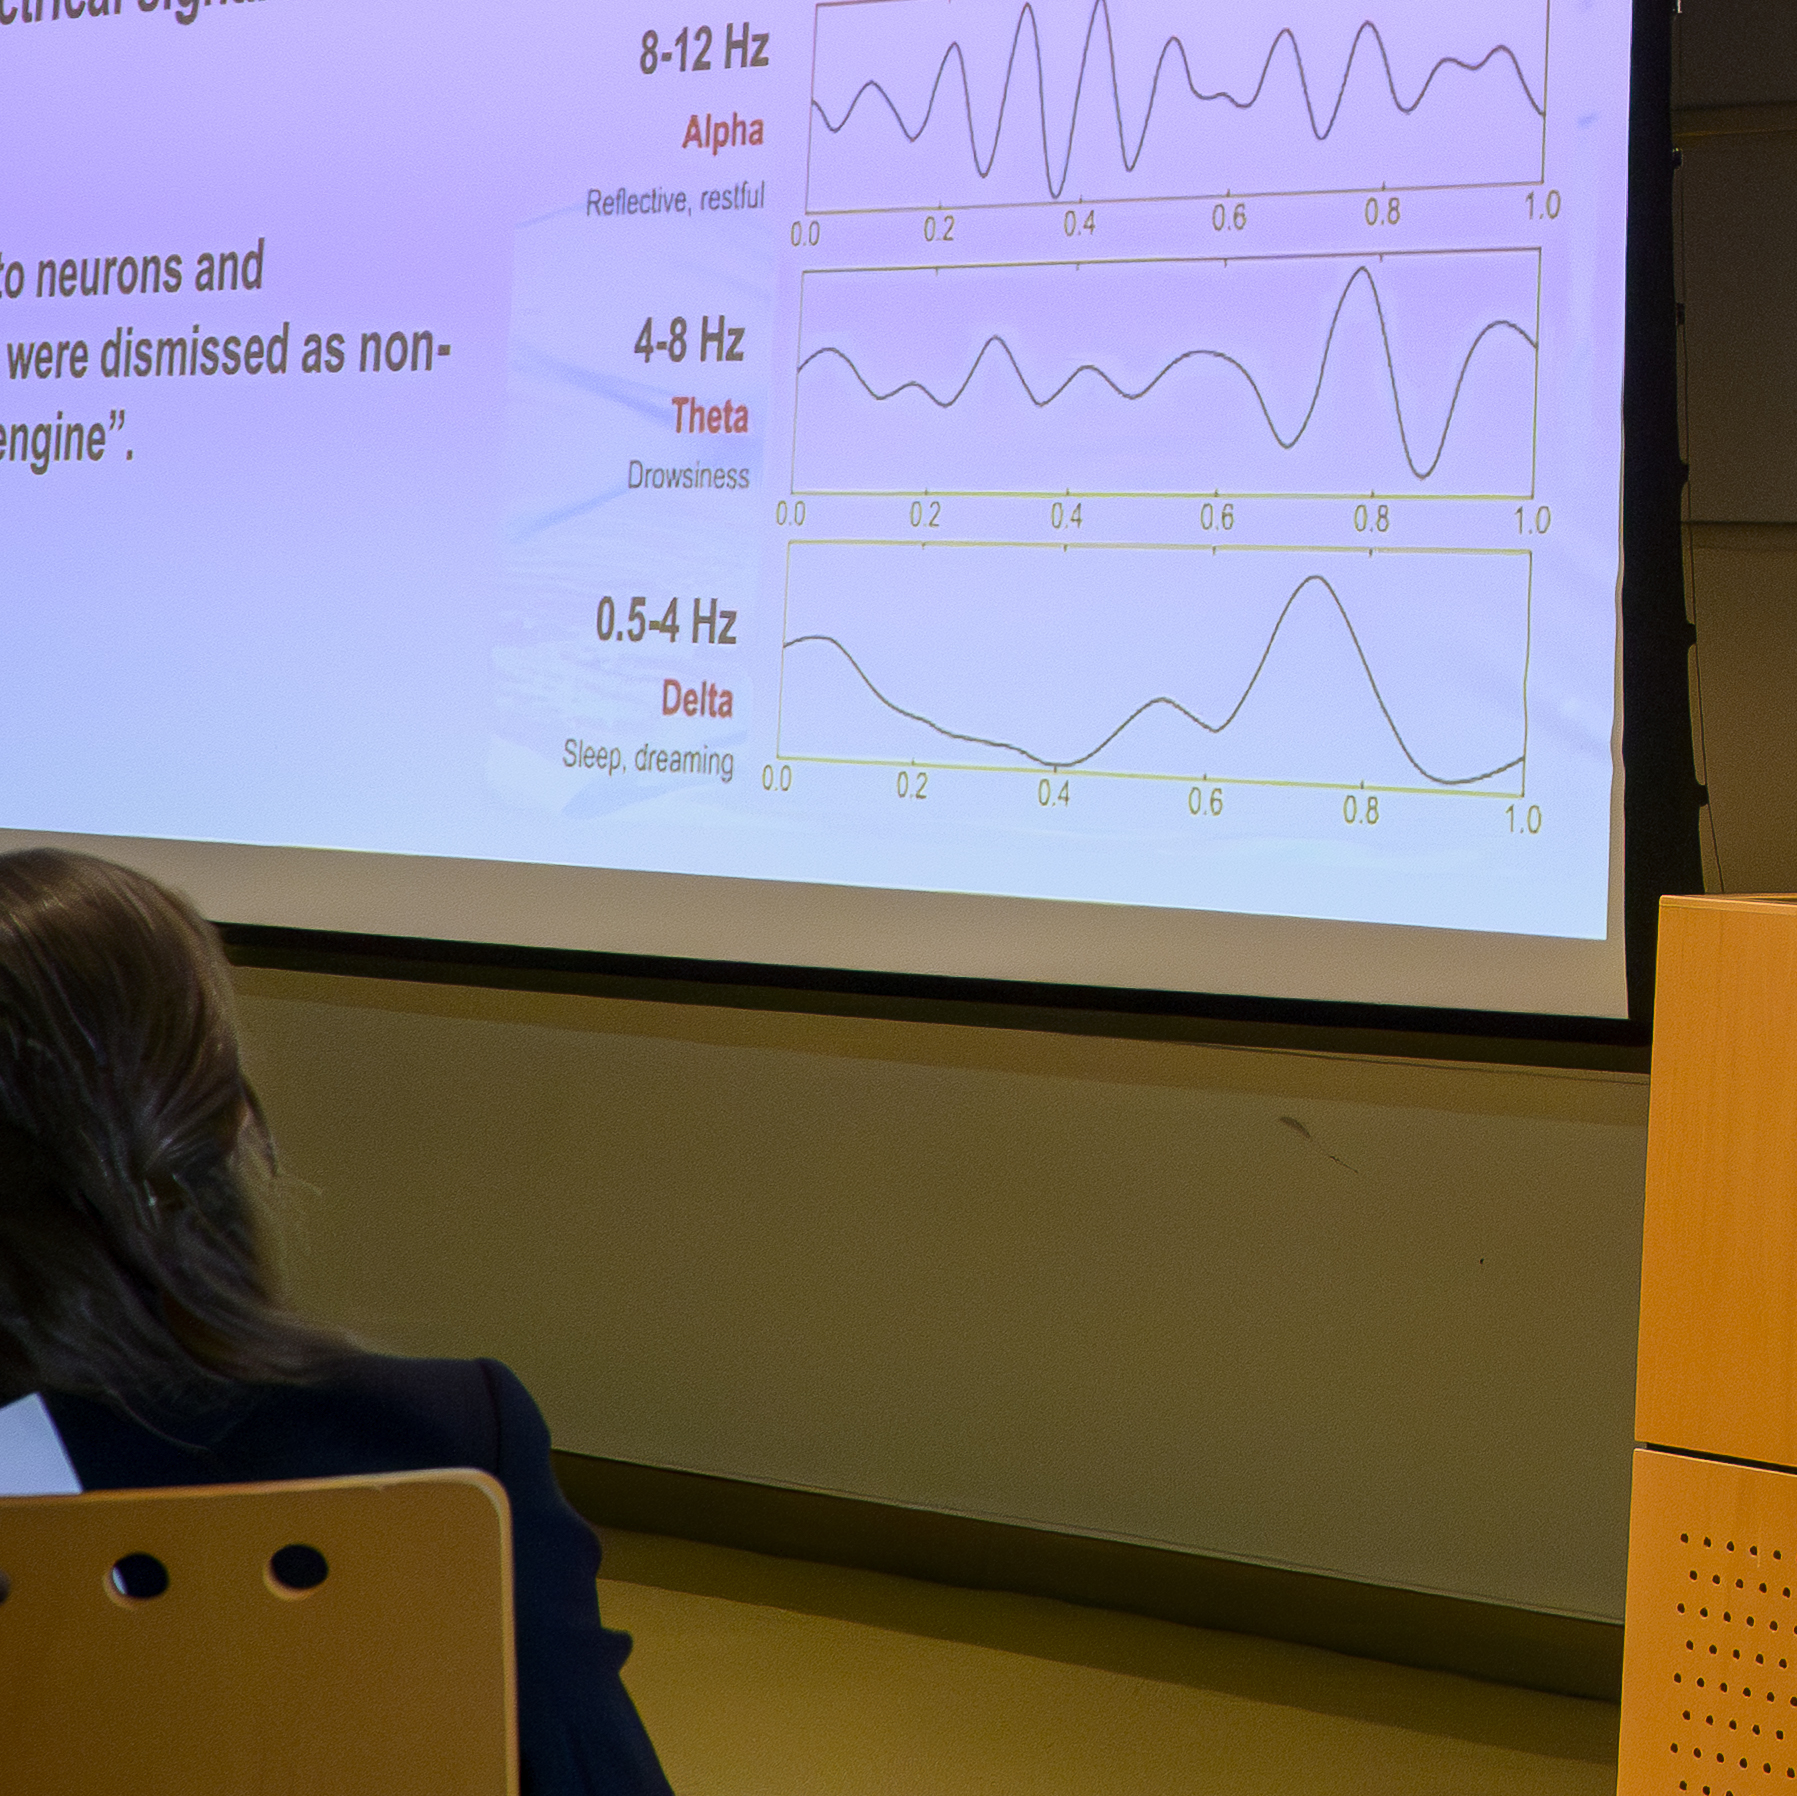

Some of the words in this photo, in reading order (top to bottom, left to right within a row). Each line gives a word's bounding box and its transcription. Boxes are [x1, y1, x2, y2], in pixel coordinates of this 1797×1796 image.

[638, 27, 712, 76] 8-12
[723, 23, 770, 70] Hz
[681, 112, 765, 154] Alpha
[585, 187, 691, 220] Reflective,
[699, 181, 767, 216] restful
[789, 218, 822, 248] 0.0
[922, 213, 956, 243] 0.2
[1062, 209, 1097, 237] 0.4
[1211, 201, 1248, 232] 0.6
[1364, 196, 1401, 227] 0.8
[1524, 190, 1563, 220] 1.0
[0, 251, 24, 299] o
[36, 250, 182, 298] neurons
[195, 237, 265, 291] and
[7, 338, 88, 380] were
[100, 321, 289, 379] dismissed
[302, 331, 344, 373] as
[359, 329, 452, 372] non-
[633, 317, 689, 364] 4-8
[699, 315, 745, 362] Hz
[671, 398, 751, 437] Theta
[627, 461, 751, 494] Drowsiness
[775, 501, 807, 530] 0.0
[909, 501, 941, 530] 0.2
[1050, 501, 1084, 531] 0.4
[1200, 501, 1236, 533] 0.6
[1353, 503, 1391, 535] 0.8
[1513, 504, 1552, 537] 1.0
[595, 596, 680, 646] 0.5-4
[690, 596, 739, 646] Hz
[660, 678, 735, 721] Delta
[561, 740, 628, 776] Sleep,
[635, 741, 735, 781] dreaming
[761, 764, 794, 793] 0.0
[896, 770, 929, 801] 0.2
[1037, 778, 1071, 809] 0.4
[1188, 786, 1224, 819] 0.6
[1342, 793, 1381, 826] 0.8
[1504, 803, 1543, 836] 1.0
